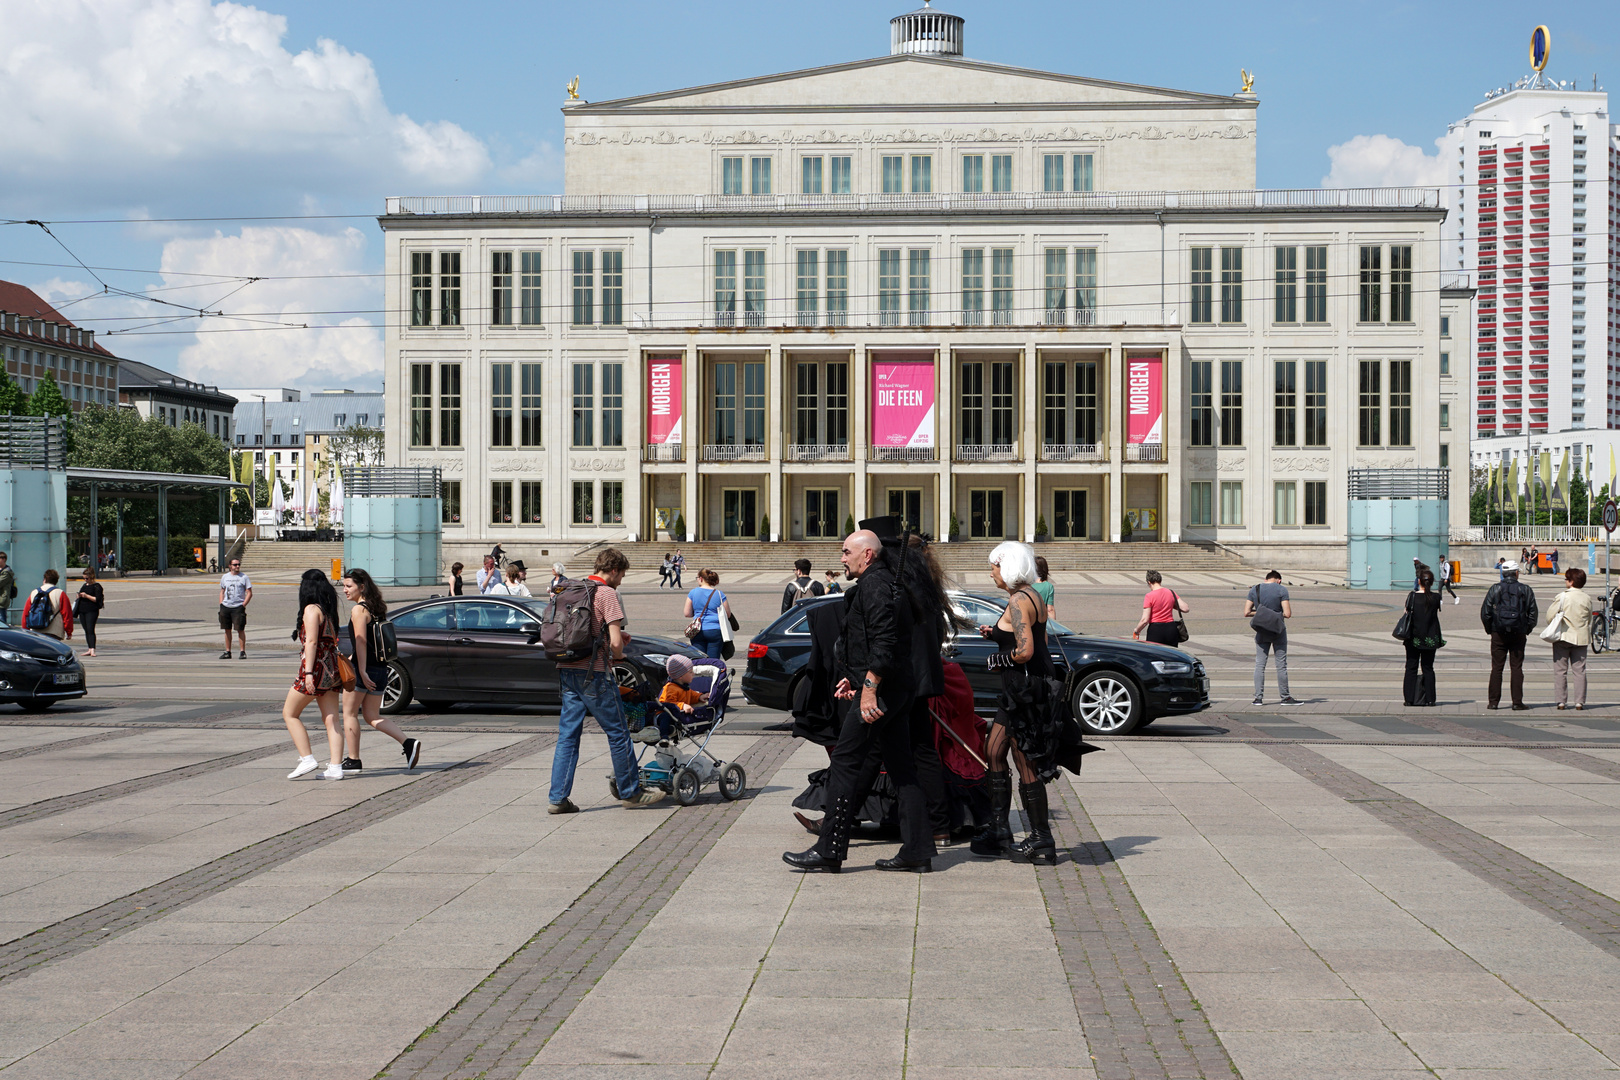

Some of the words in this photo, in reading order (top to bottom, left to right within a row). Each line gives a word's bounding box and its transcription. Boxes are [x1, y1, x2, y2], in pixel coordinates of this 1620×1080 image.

[651, 363, 671, 415] MORGEN
[878, 390, 896, 406] DIE
[898, 390, 922, 406] FEEN
[1129, 362, 1149, 415] MORGEN
[1606, 509, 1615, 524] 20
